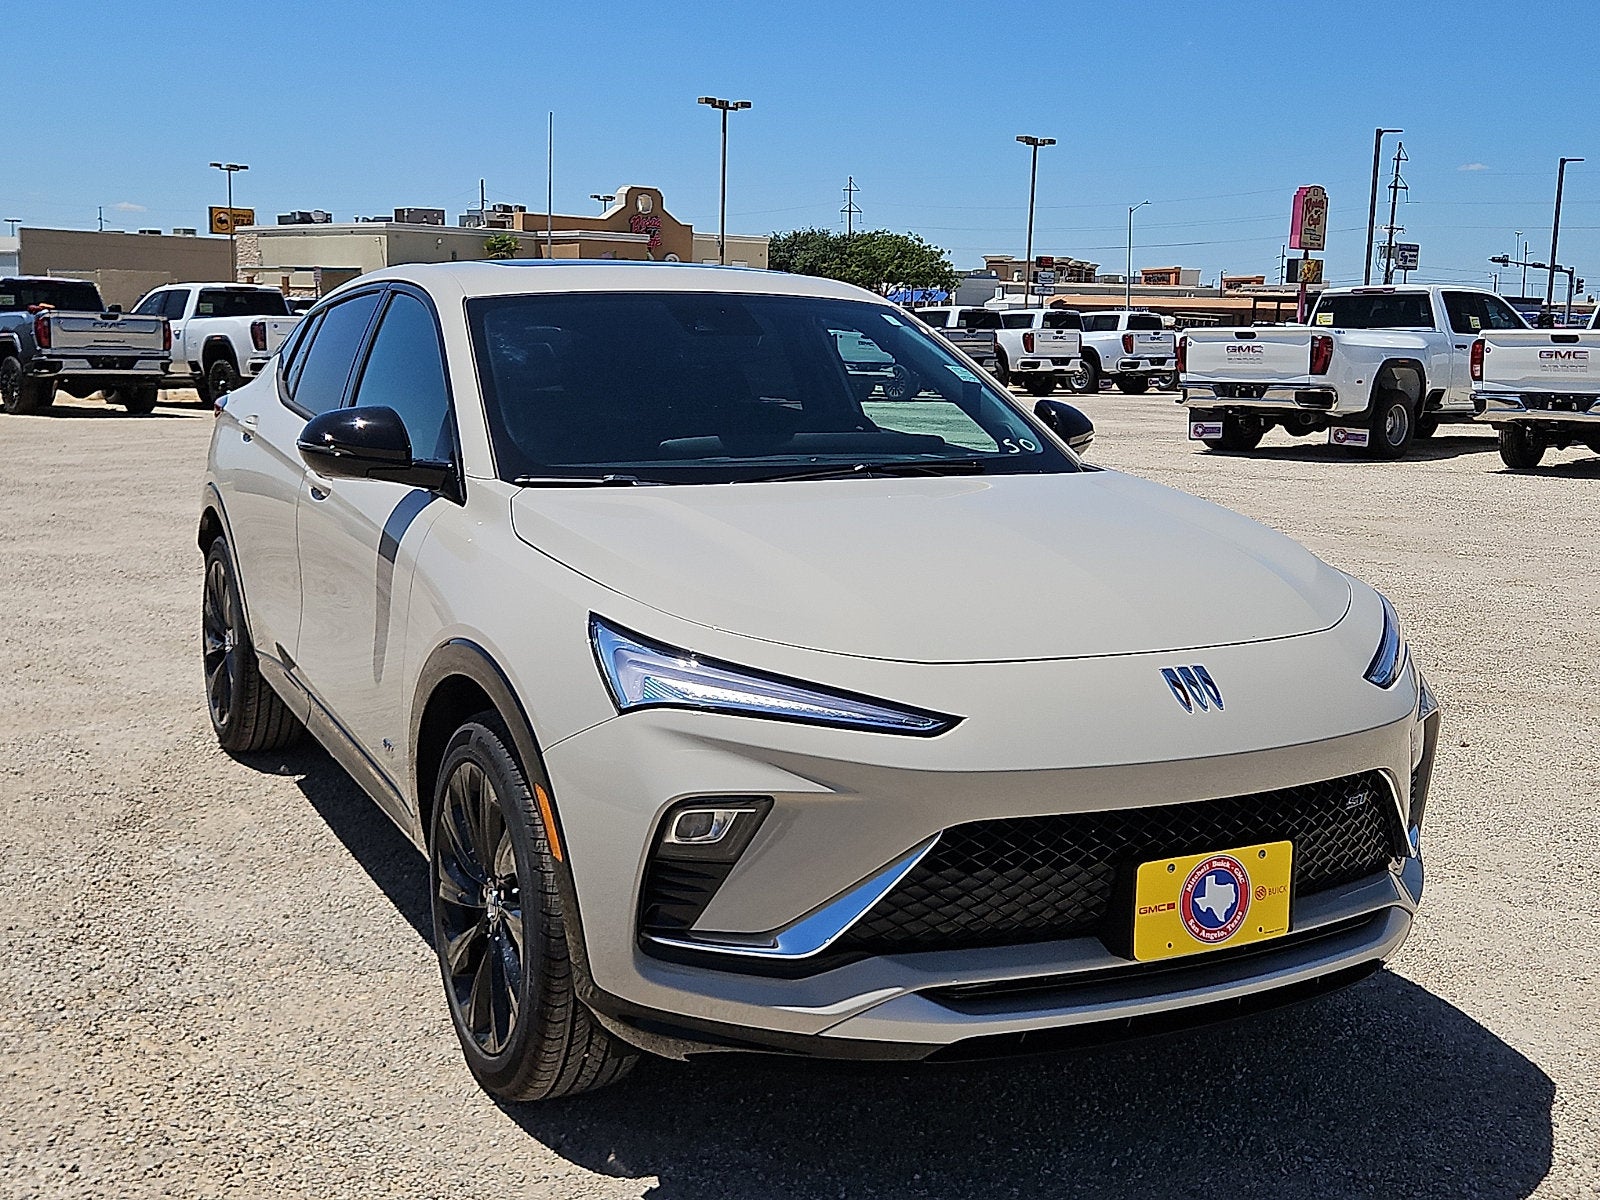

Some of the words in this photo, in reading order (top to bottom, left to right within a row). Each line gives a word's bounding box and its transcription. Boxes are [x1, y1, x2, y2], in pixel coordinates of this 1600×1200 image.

[1226, 345, 1264, 353] GMC
[1538, 350, 1589, 360] GMC
[1186, 863, 1209, 892] Mitchell
[1268, 885, 1287, 896] BUICK
[1138, 904, 1167, 915] GMC
[1188, 918, 1200, 933] San
[1199, 929, 1228, 940] Angelo,
[1226, 910, 1243, 931] Texas
